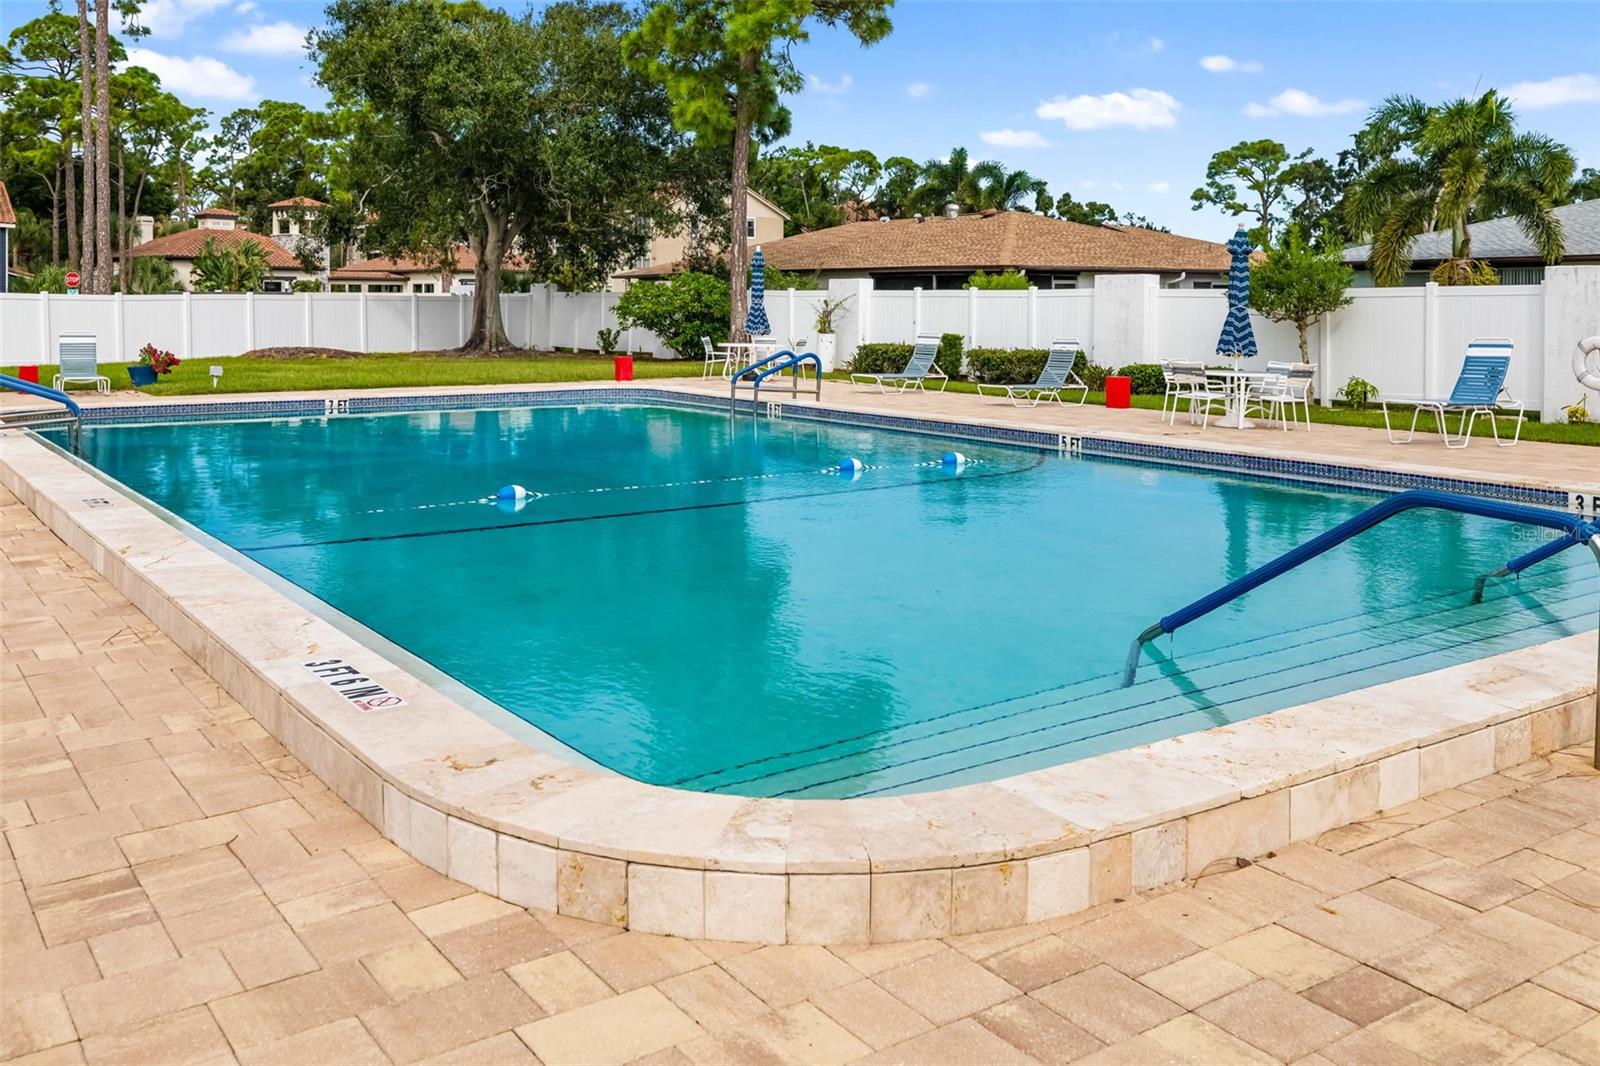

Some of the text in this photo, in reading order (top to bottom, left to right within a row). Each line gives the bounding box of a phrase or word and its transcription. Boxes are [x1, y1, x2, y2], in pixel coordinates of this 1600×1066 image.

[1062, 435, 1081, 450] 5 FT
[1575, 494, 1585, 510] 3
[304, 659, 389, 700] 3 FT 6 IN
